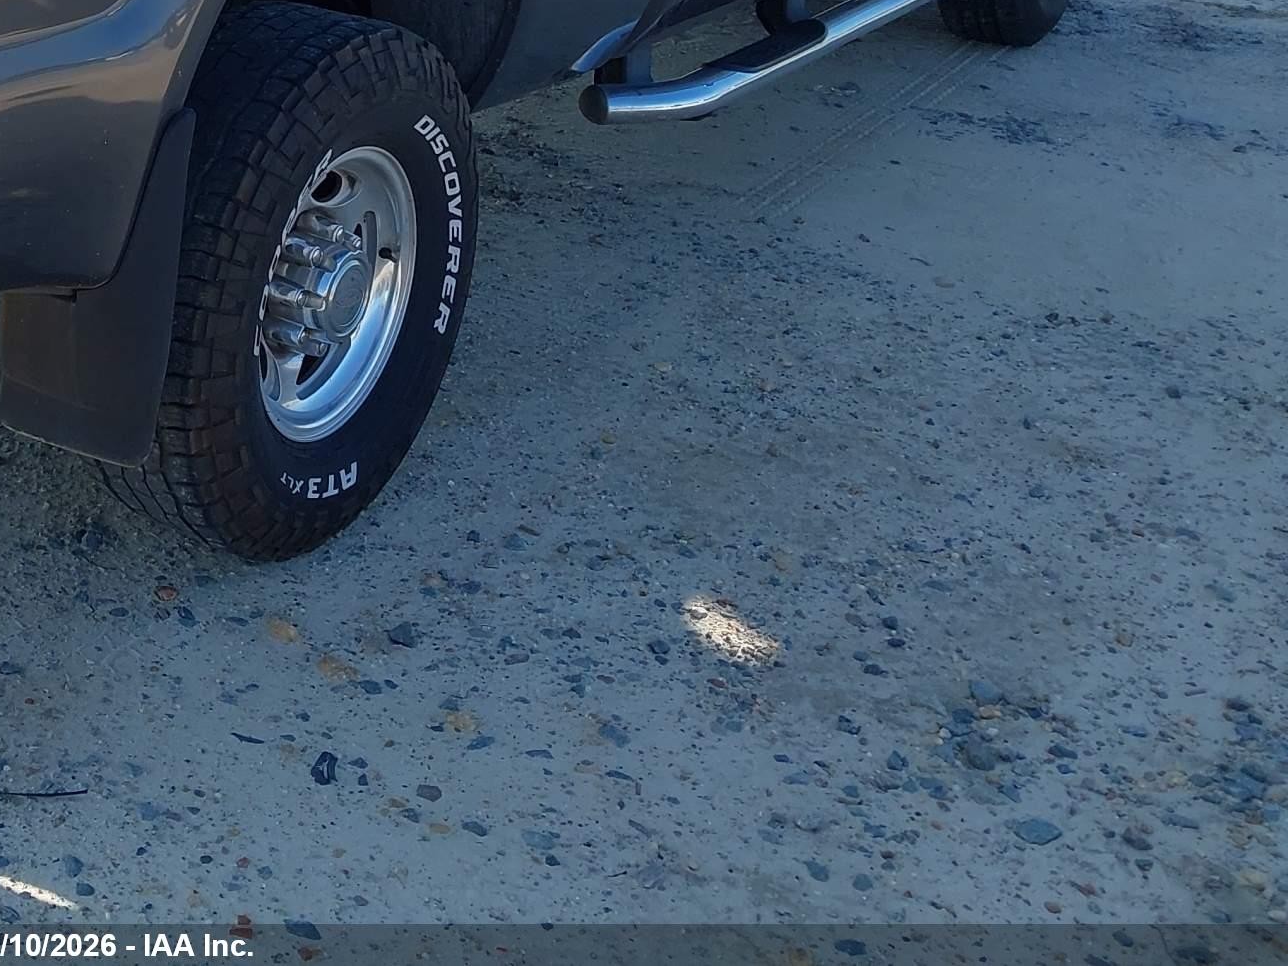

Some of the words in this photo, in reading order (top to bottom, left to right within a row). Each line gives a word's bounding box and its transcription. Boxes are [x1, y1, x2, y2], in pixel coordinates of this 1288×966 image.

[413, 114, 463, 335] DISCOVERER
[279, 472, 305, 495] XLT
[306, 461, 358, 499] AT3
